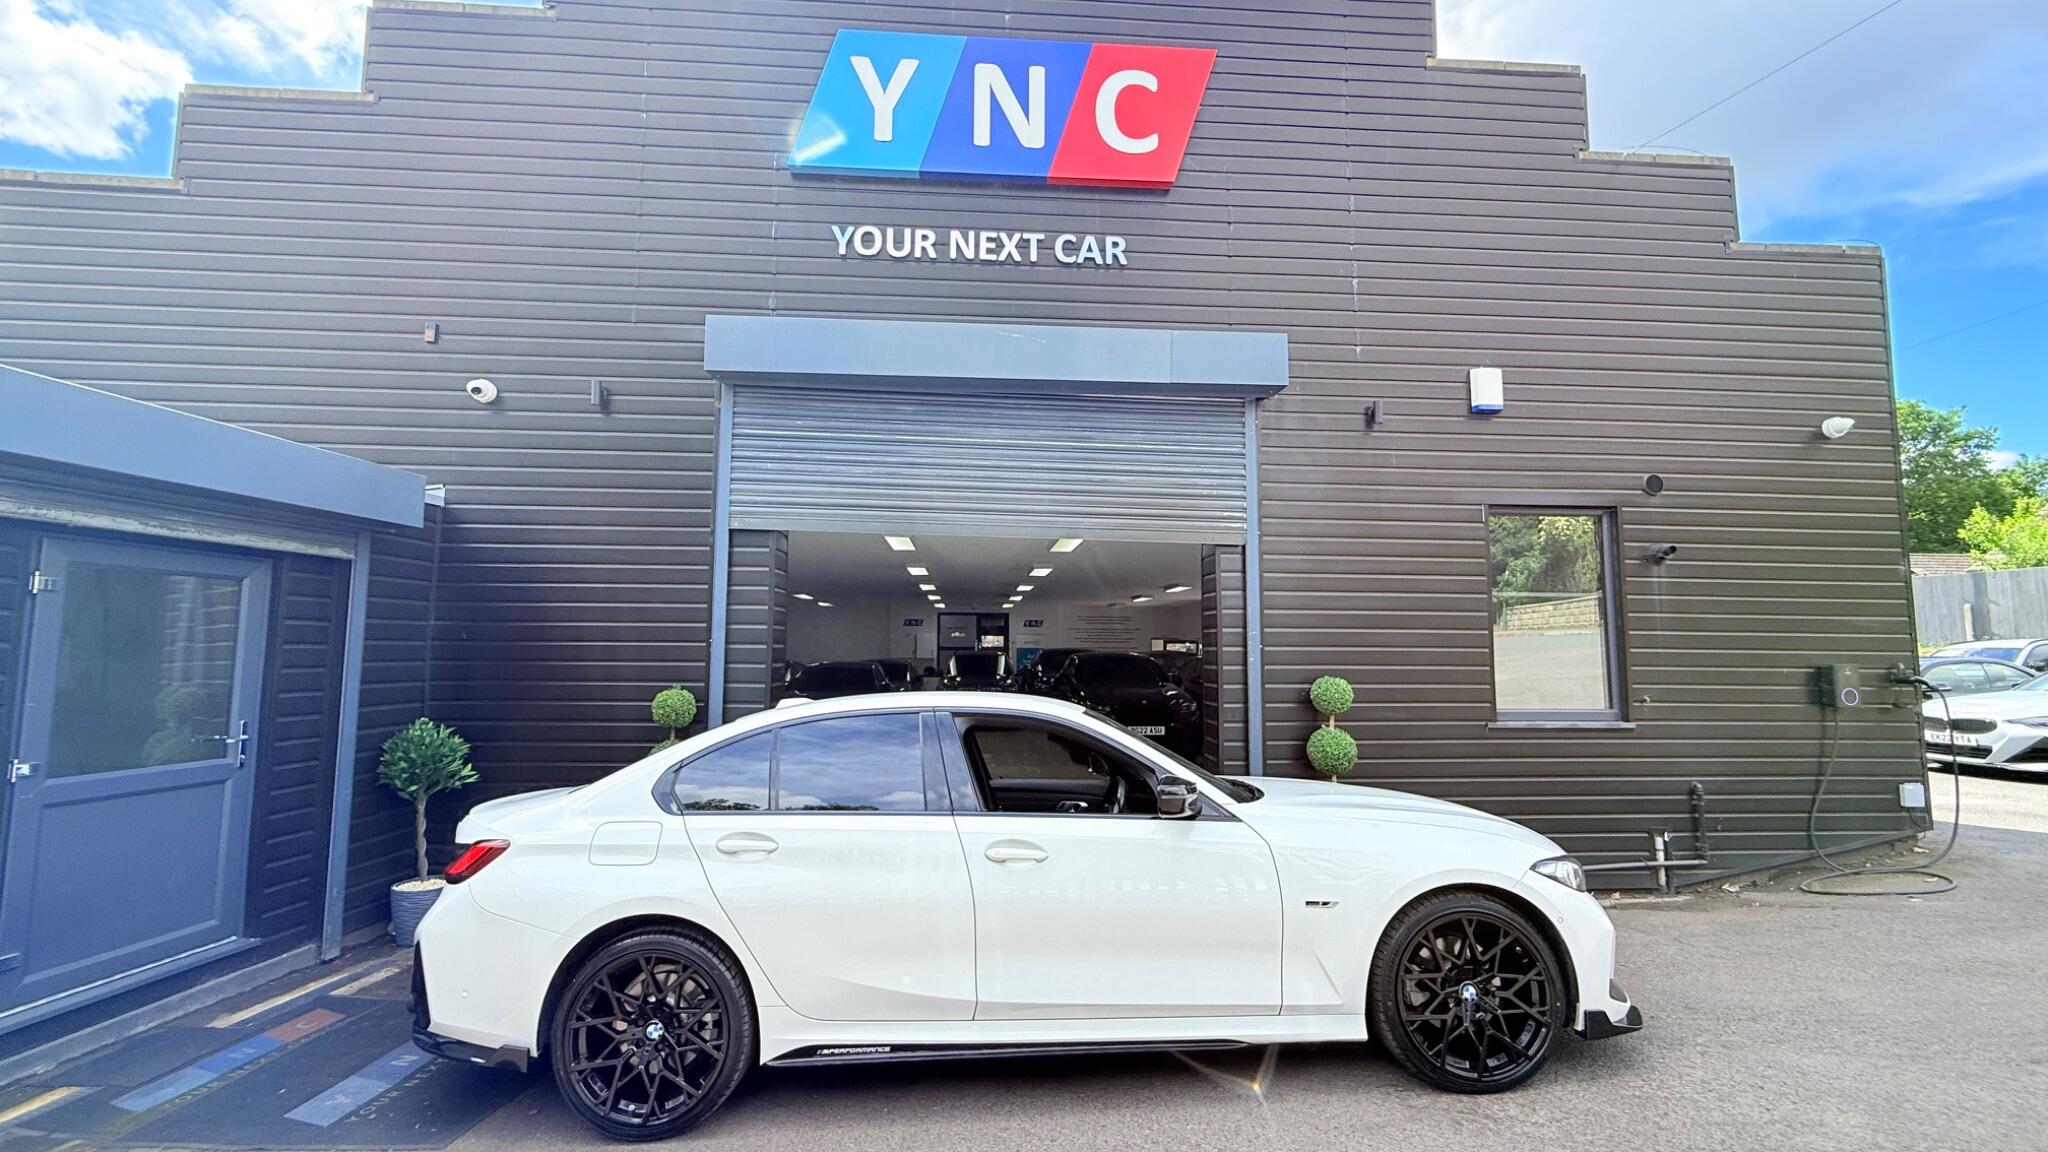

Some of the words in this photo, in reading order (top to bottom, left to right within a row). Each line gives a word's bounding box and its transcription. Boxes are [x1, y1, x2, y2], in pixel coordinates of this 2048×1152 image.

[850, 56, 1159, 154] YNC
[831, 225, 937, 259] YOUR
[950, 230, 1045, 262] NEXT
[1054, 234, 1128, 265] CAR
[1954, 735, 1972, 744] YTA
[344, 1090, 400, 1123] YOUR
[403, 1057, 449, 1088] NEXT
